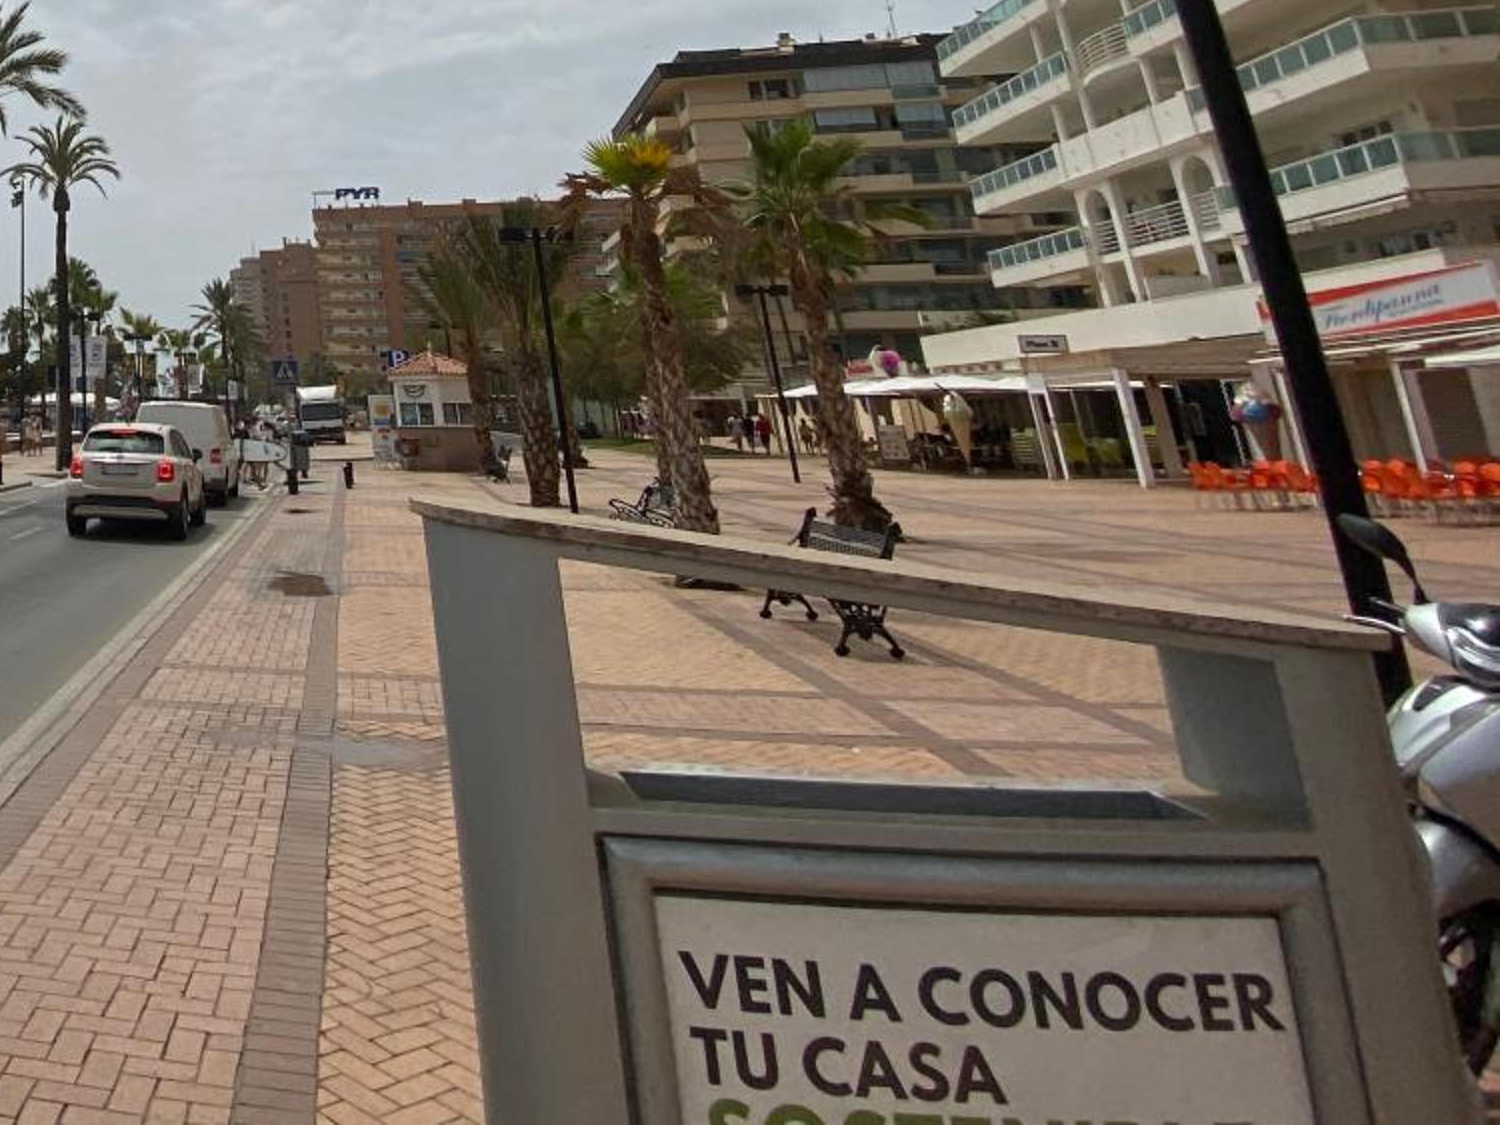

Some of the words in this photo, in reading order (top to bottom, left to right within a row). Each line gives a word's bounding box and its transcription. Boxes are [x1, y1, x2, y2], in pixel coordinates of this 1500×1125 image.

[335, 186, 379, 200] PYR
[677, 950, 826, 1019] VEN
[849, 963, 903, 1022] A
[917, 966, 1286, 1033] CONOCER
[689, 1025, 780, 1091] TU
[801, 1035, 1009, 1106] CASA
